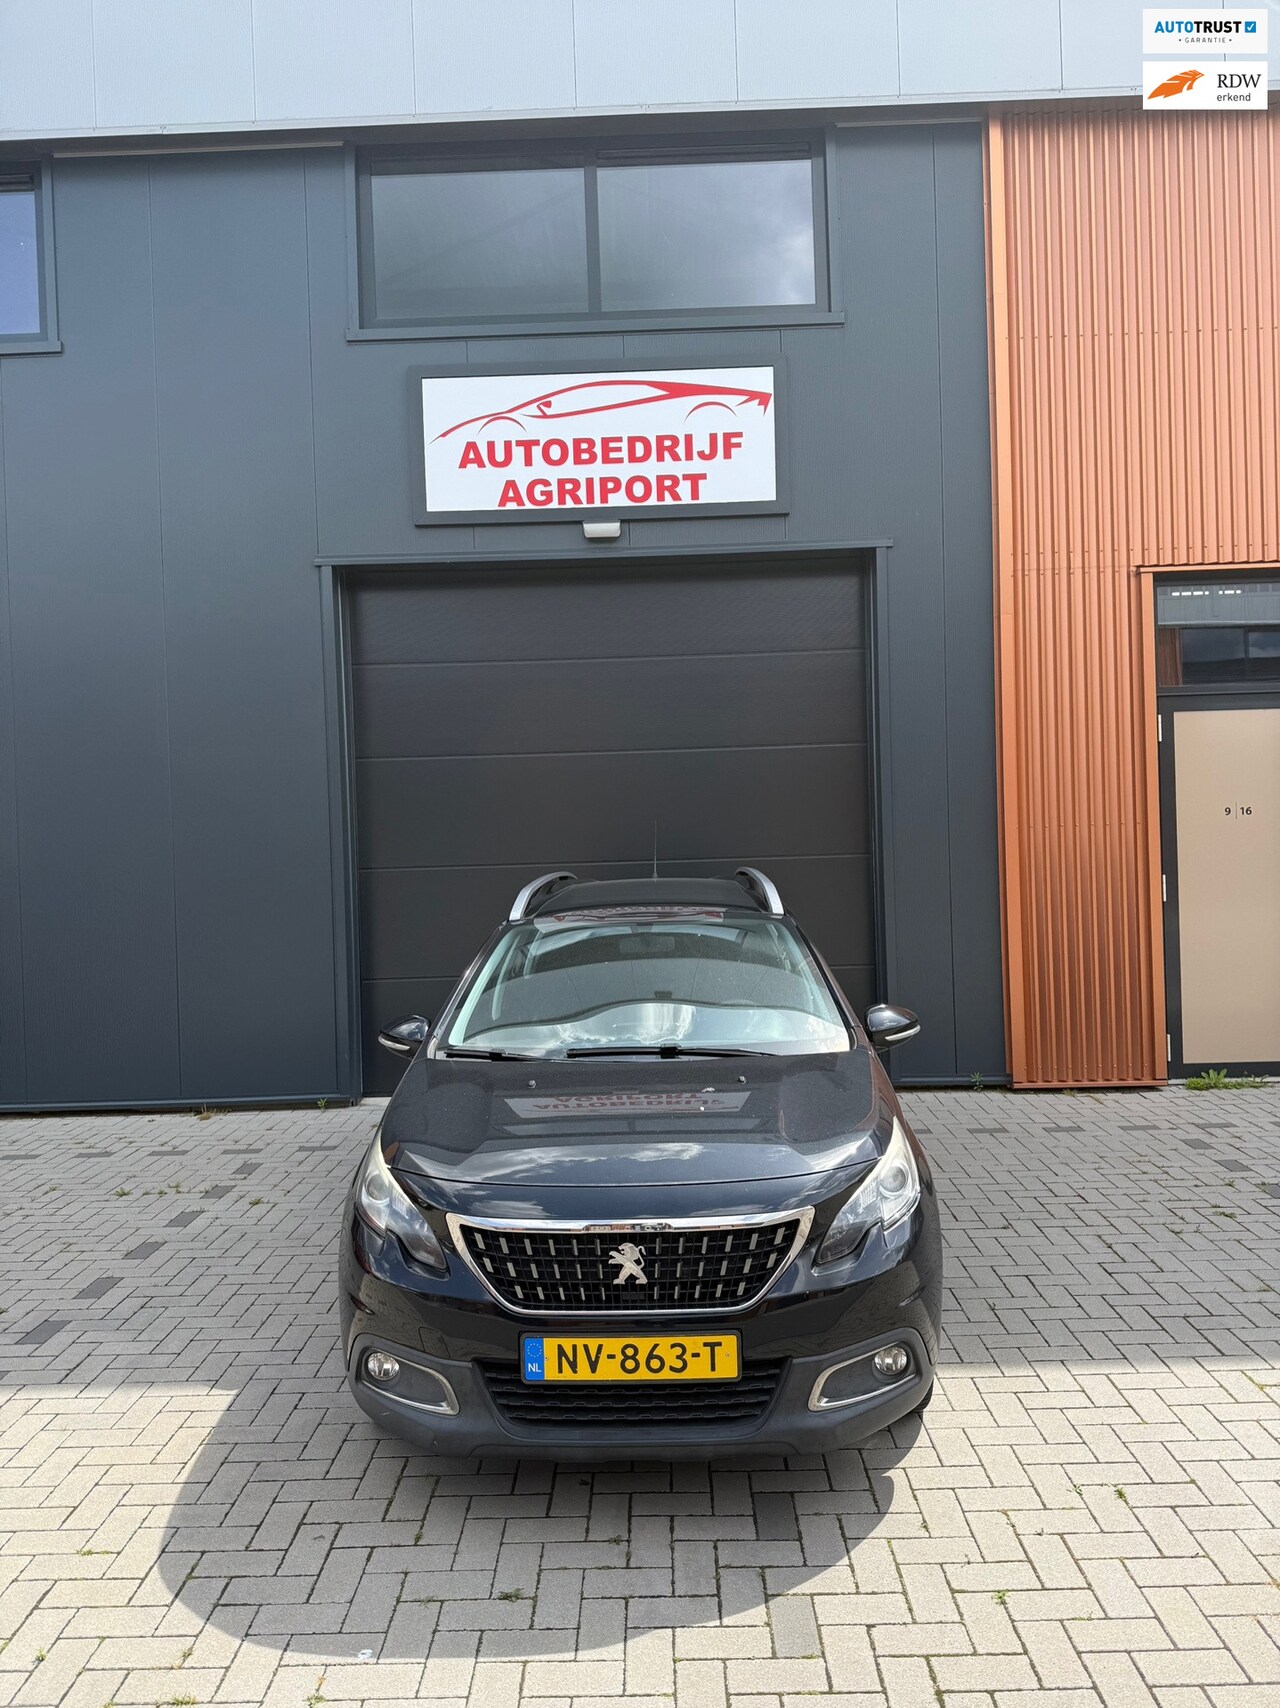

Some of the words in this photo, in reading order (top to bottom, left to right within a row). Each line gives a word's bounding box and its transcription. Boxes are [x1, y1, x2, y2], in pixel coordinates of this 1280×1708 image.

[458, 431, 744, 469] AUTOBEDRIJF
[497, 473, 708, 508] AGRIPORT
[1224, 806, 1231, 816] 9
[1240, 806, 1252, 816] 16
[527, 1363, 542, 1373] NL
[556, 1341, 723, 1375] NV-863-T
